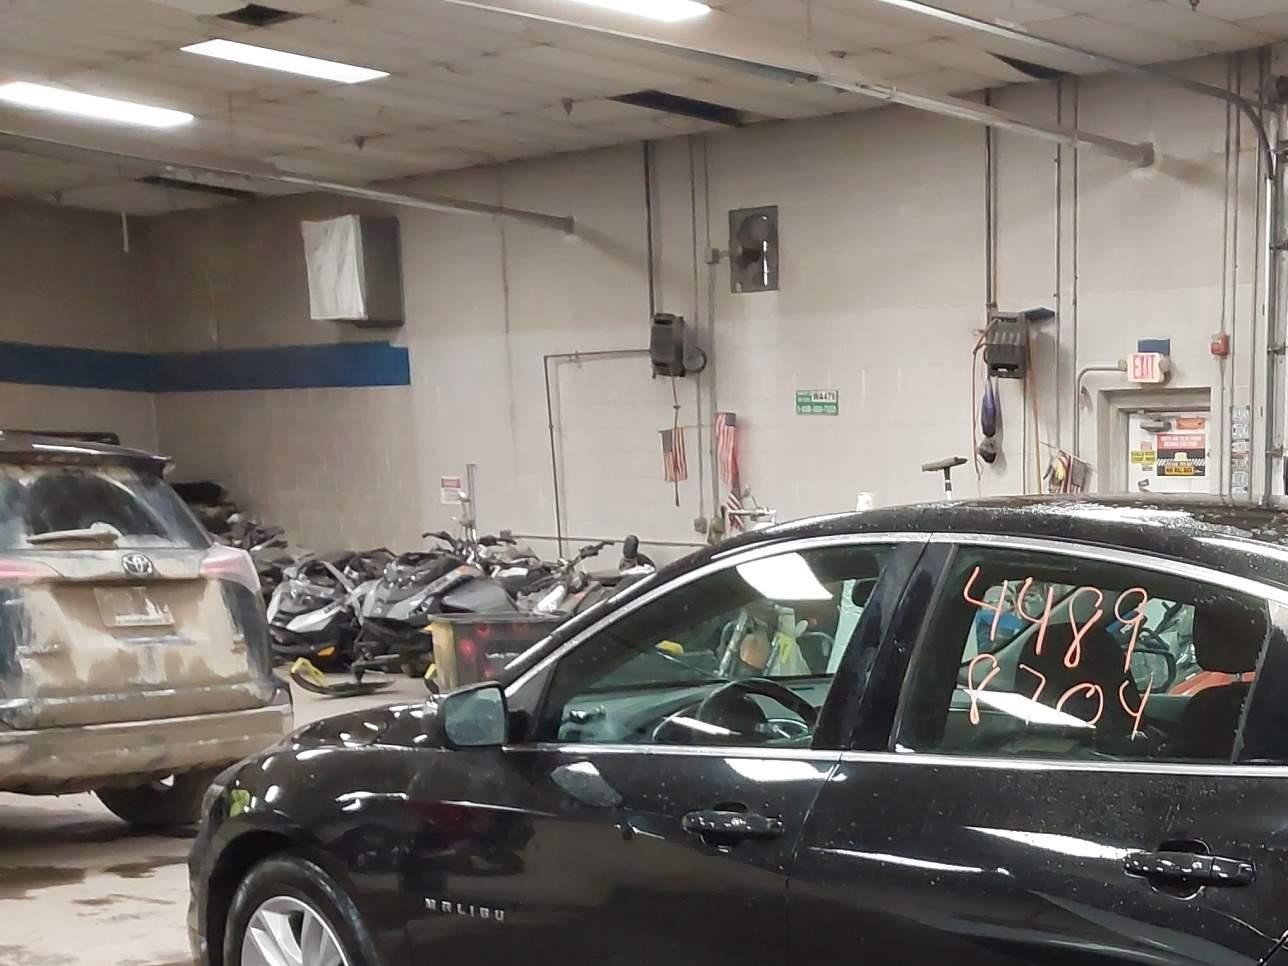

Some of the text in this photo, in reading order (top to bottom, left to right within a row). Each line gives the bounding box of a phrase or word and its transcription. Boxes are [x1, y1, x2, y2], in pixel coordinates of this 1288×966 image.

[1133, 354, 1155, 380] EXIT
[963, 566, 1148, 674] 4489
[967, 653, 1154, 742] 8704
[424, 897, 505, 921] MALIBU
